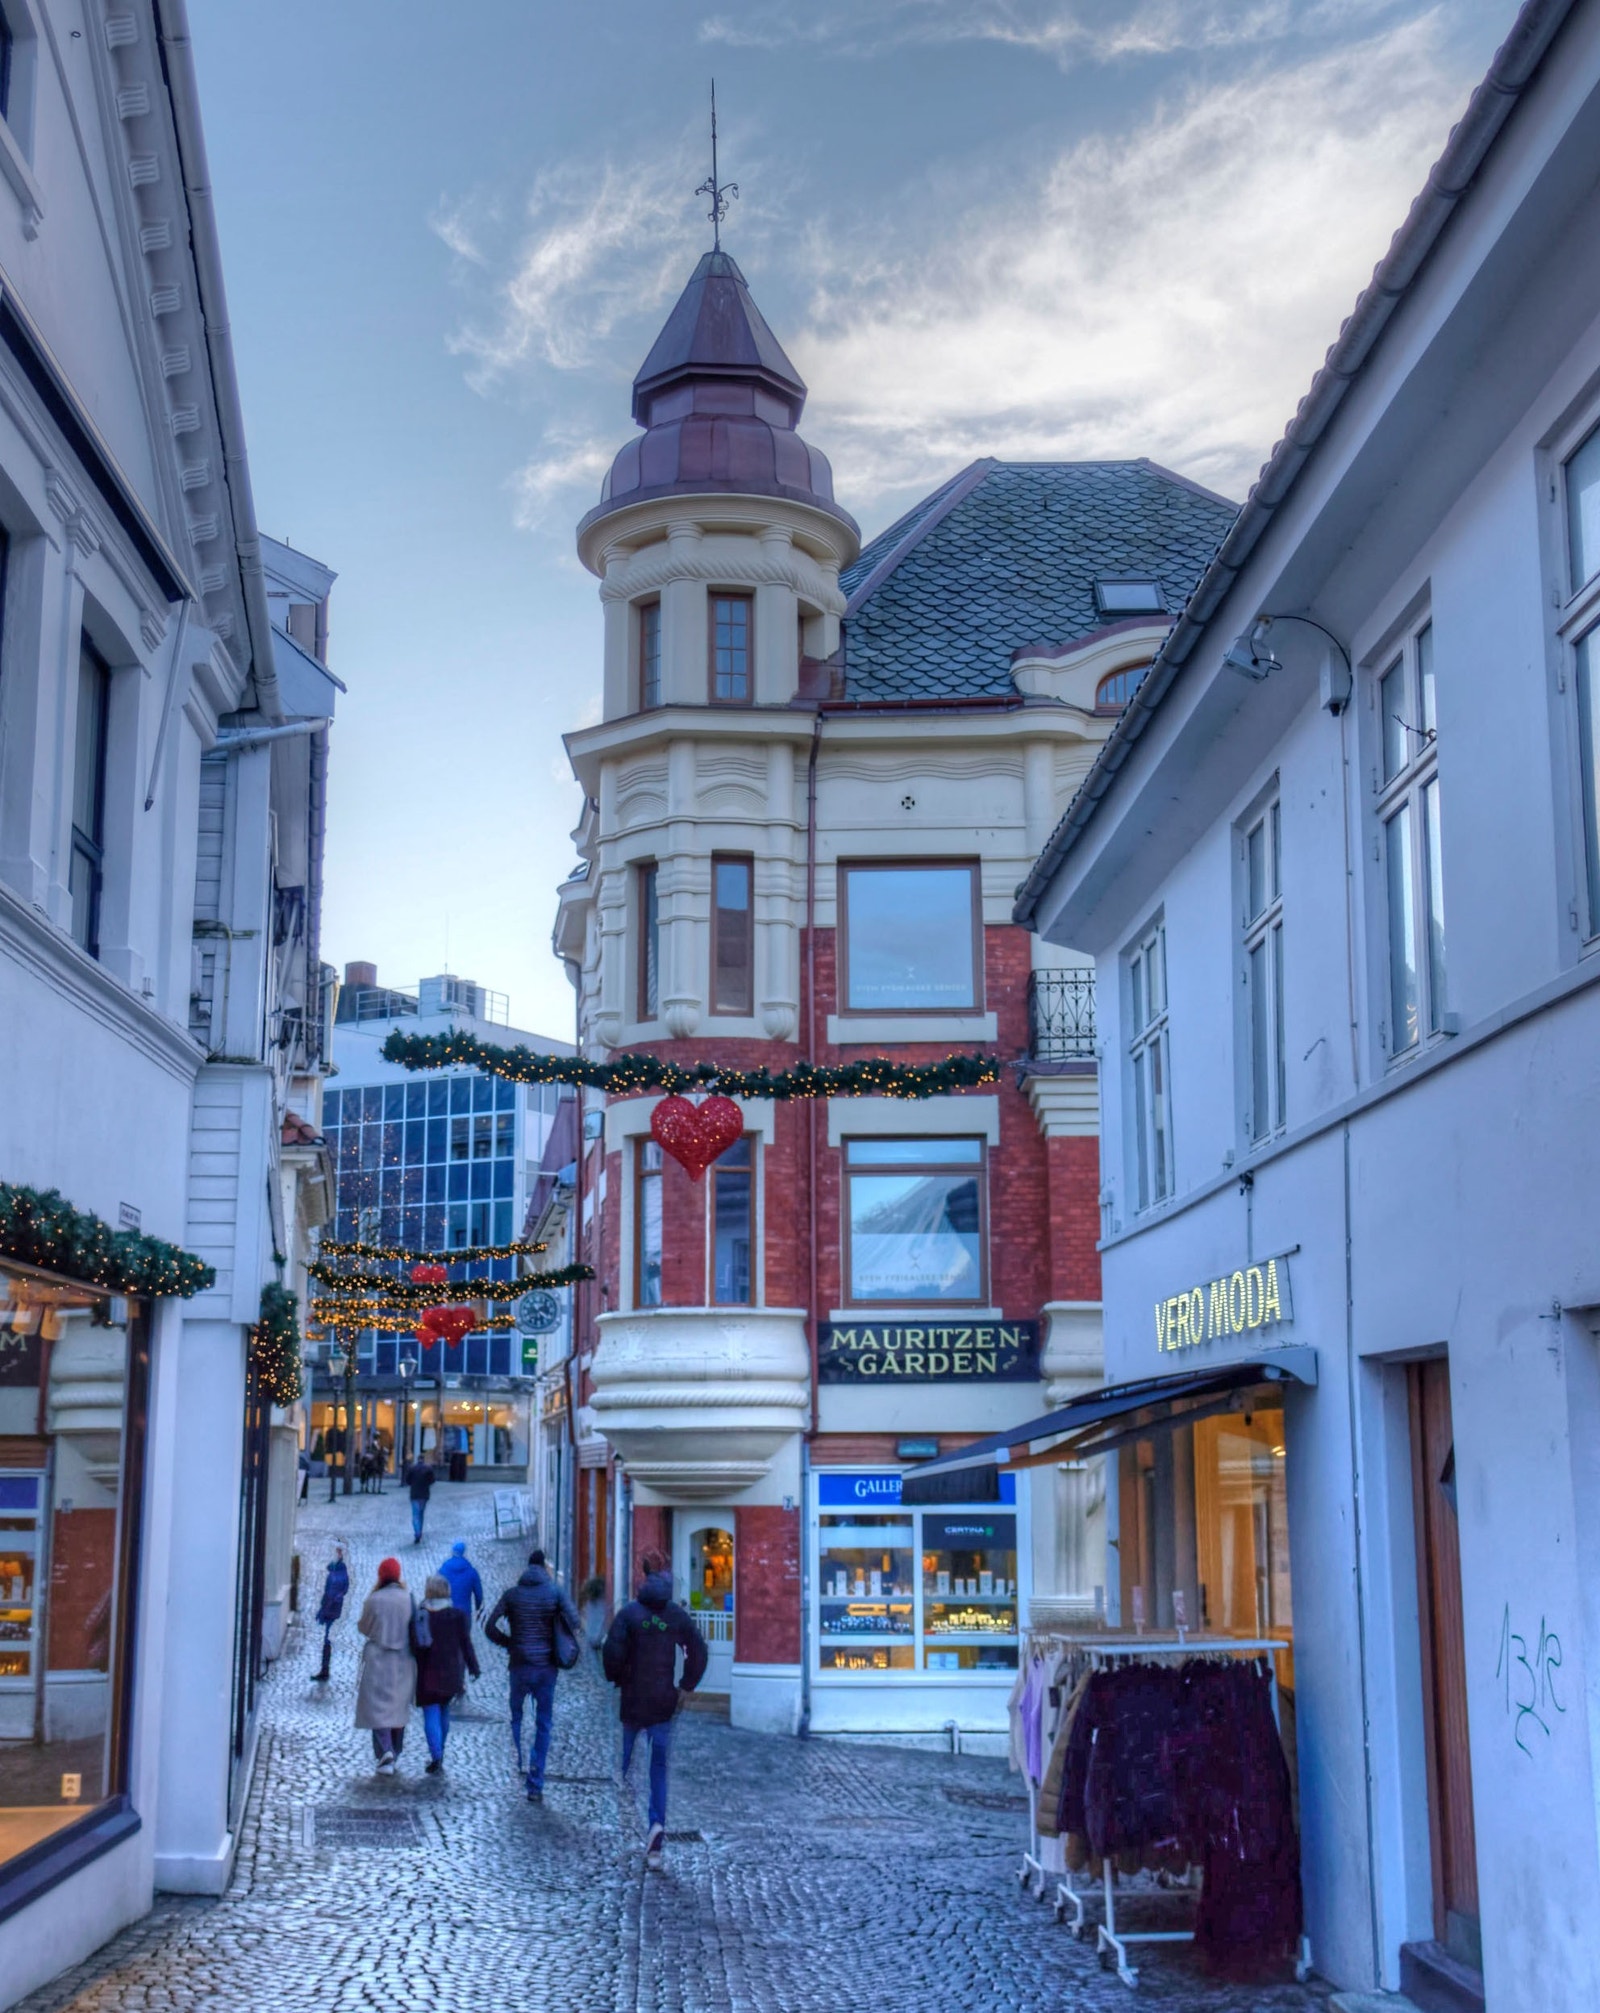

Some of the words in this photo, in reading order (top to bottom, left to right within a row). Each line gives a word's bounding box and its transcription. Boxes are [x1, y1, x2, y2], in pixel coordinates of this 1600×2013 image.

[1154, 1287, 1204, 1352] VERO
[1207, 1259, 1281, 1339] MODA
[831, 1327, 1030, 1350] MAURITZEN-
[858, 1352, 997, 1374] GÅRDEN
